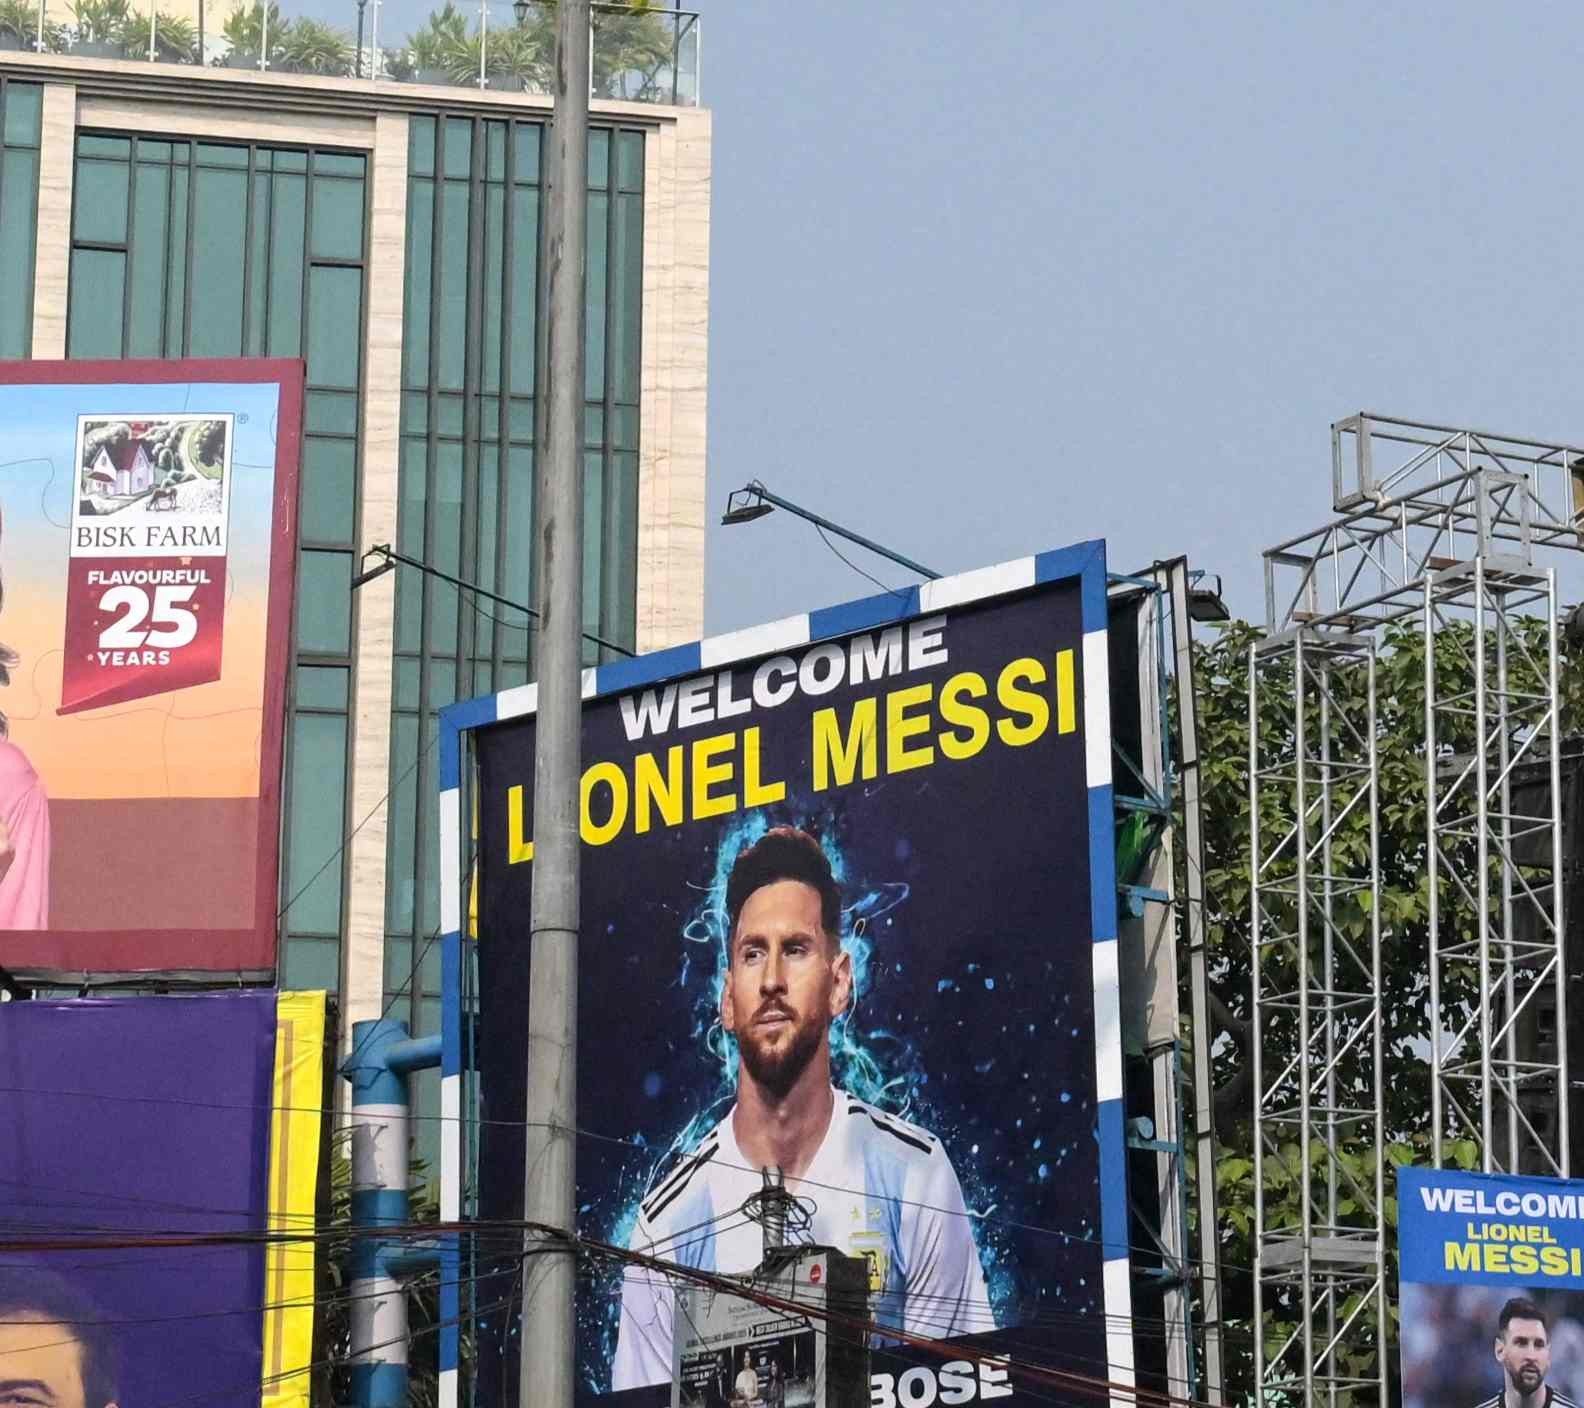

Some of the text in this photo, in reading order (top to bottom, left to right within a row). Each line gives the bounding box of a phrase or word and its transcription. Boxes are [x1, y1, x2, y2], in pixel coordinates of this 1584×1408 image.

[76, 525, 223, 548] BISK FARM
[88, 569, 211, 585] FLAVOURFUL
[98, 585, 198, 650] 25
[97, 650, 170, 666] YEARS
[620, 616, 949, 741] WELCOME
[508, 649, 1080, 866] LONEL MESSI
[1467, 1222, 1557, 1245] LIONEL
[1444, 1242, 1582, 1276] MESSI
